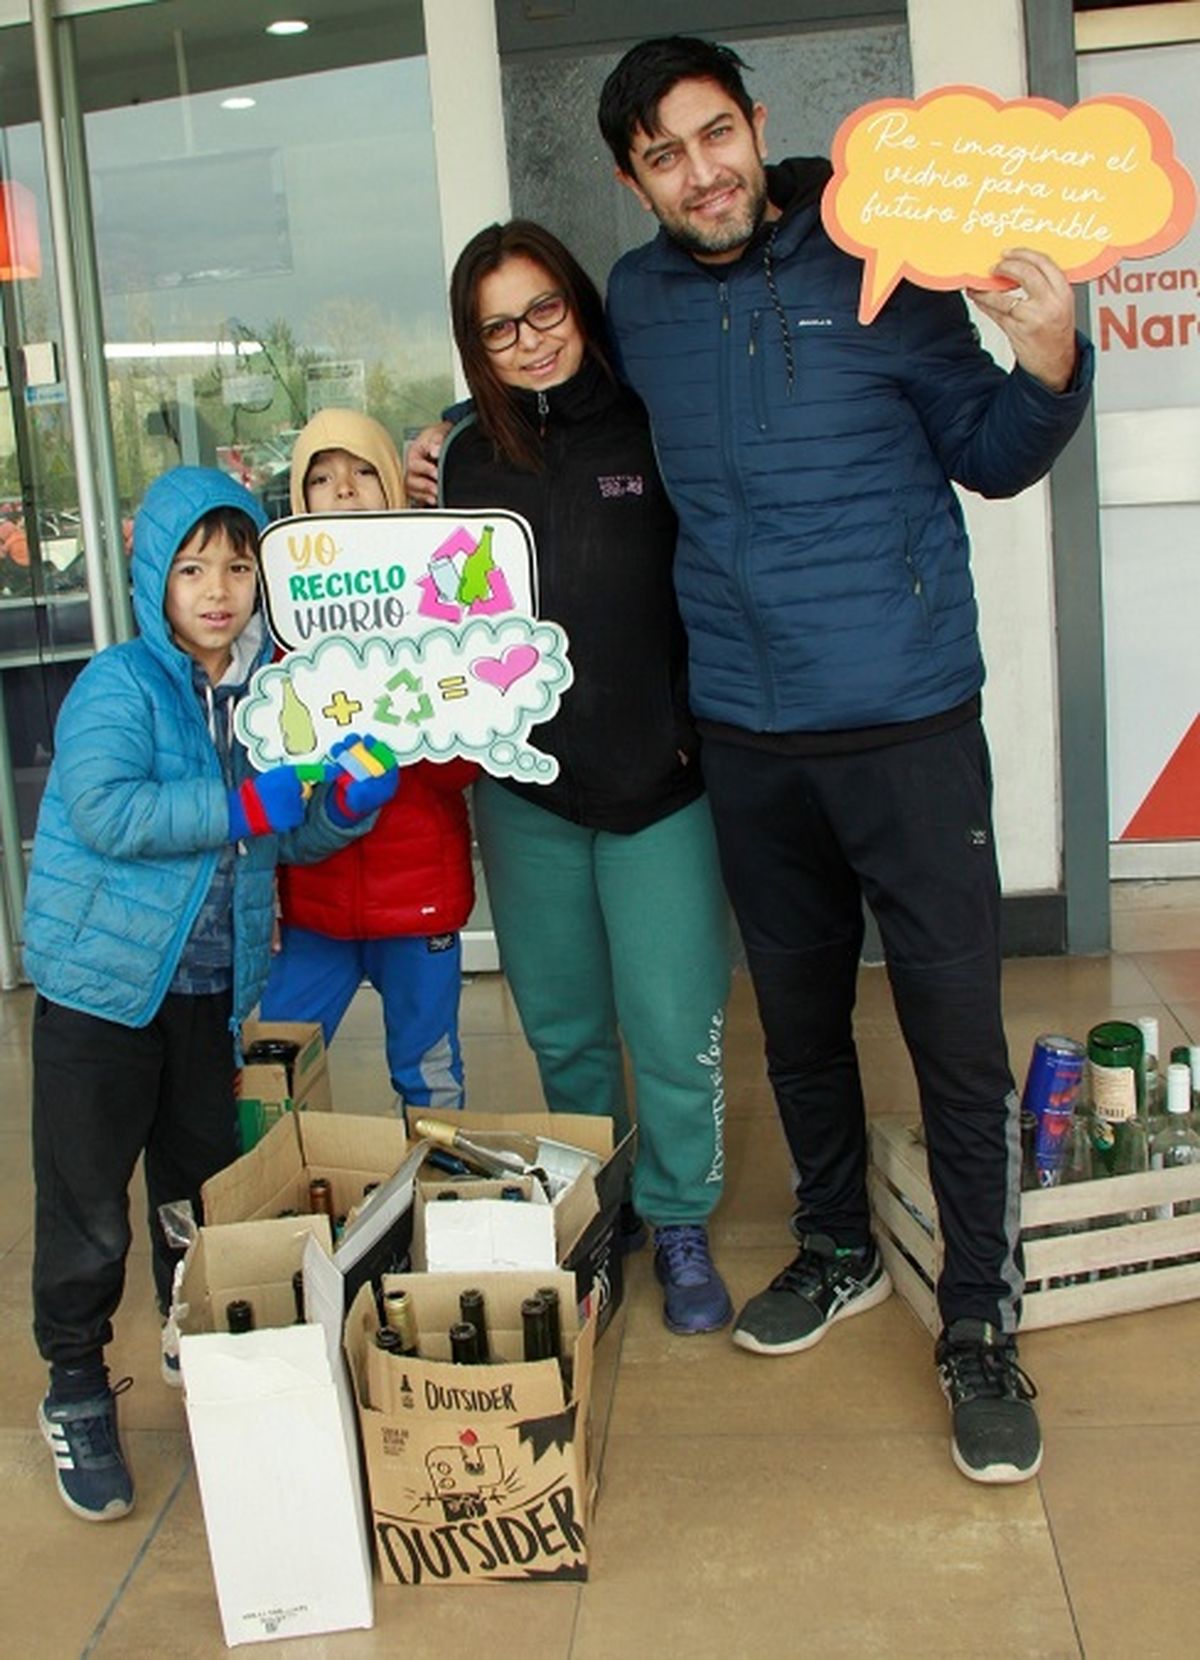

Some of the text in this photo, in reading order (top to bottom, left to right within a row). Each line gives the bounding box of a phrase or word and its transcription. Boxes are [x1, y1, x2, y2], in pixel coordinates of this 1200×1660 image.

[867, 111, 920, 152] Re
[952, 136, 1096, 175] imaginar
[1106, 146, 1139, 173] el
[883, 159, 1106, 205] vidrio para un
[860, 191, 1113, 242] futuro sostenible
[1097, 266, 1200, 298] Naran
[1098, 304, 1200, 352] Nar
[288, 565, 406, 601] RECICLO
[294, 597, 410, 640] VIDRIO
[425, 1379, 518, 1412] OUTSIDER
[376, 1486, 587, 1584] OUTSIDER
